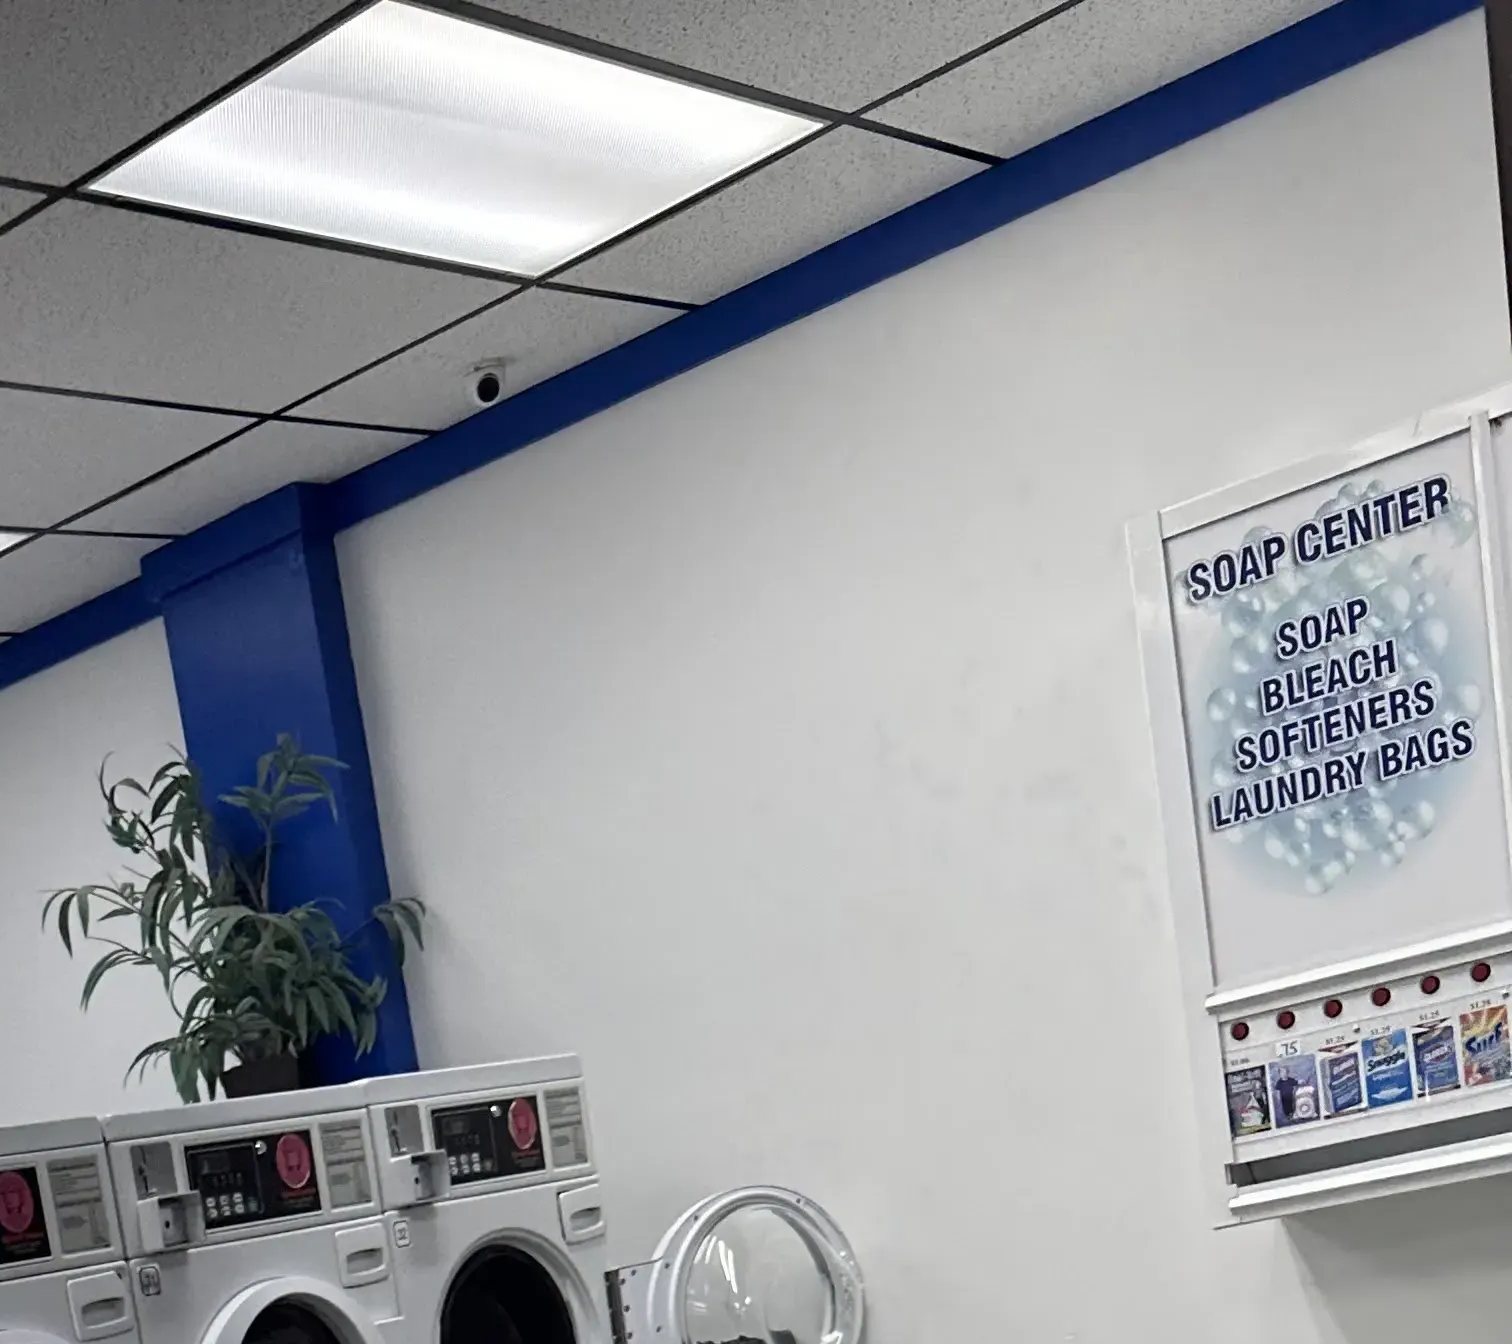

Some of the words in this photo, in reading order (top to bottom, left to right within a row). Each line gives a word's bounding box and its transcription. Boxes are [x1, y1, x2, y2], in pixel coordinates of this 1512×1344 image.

[1189, 535, 1286, 602] SOAP
[1296, 475, 1450, 563] CENTER
[1277, 598, 1368, 658] SOAP
[1262, 640, 1397, 714] BLEACH
[1236, 680, 1436, 772] SOFTENERS
[1212, 752, 1367, 829] LAUNDRY
[1380, 720, 1473, 779] BAGS
[1465, 1021, 1503, 1055] Surf
